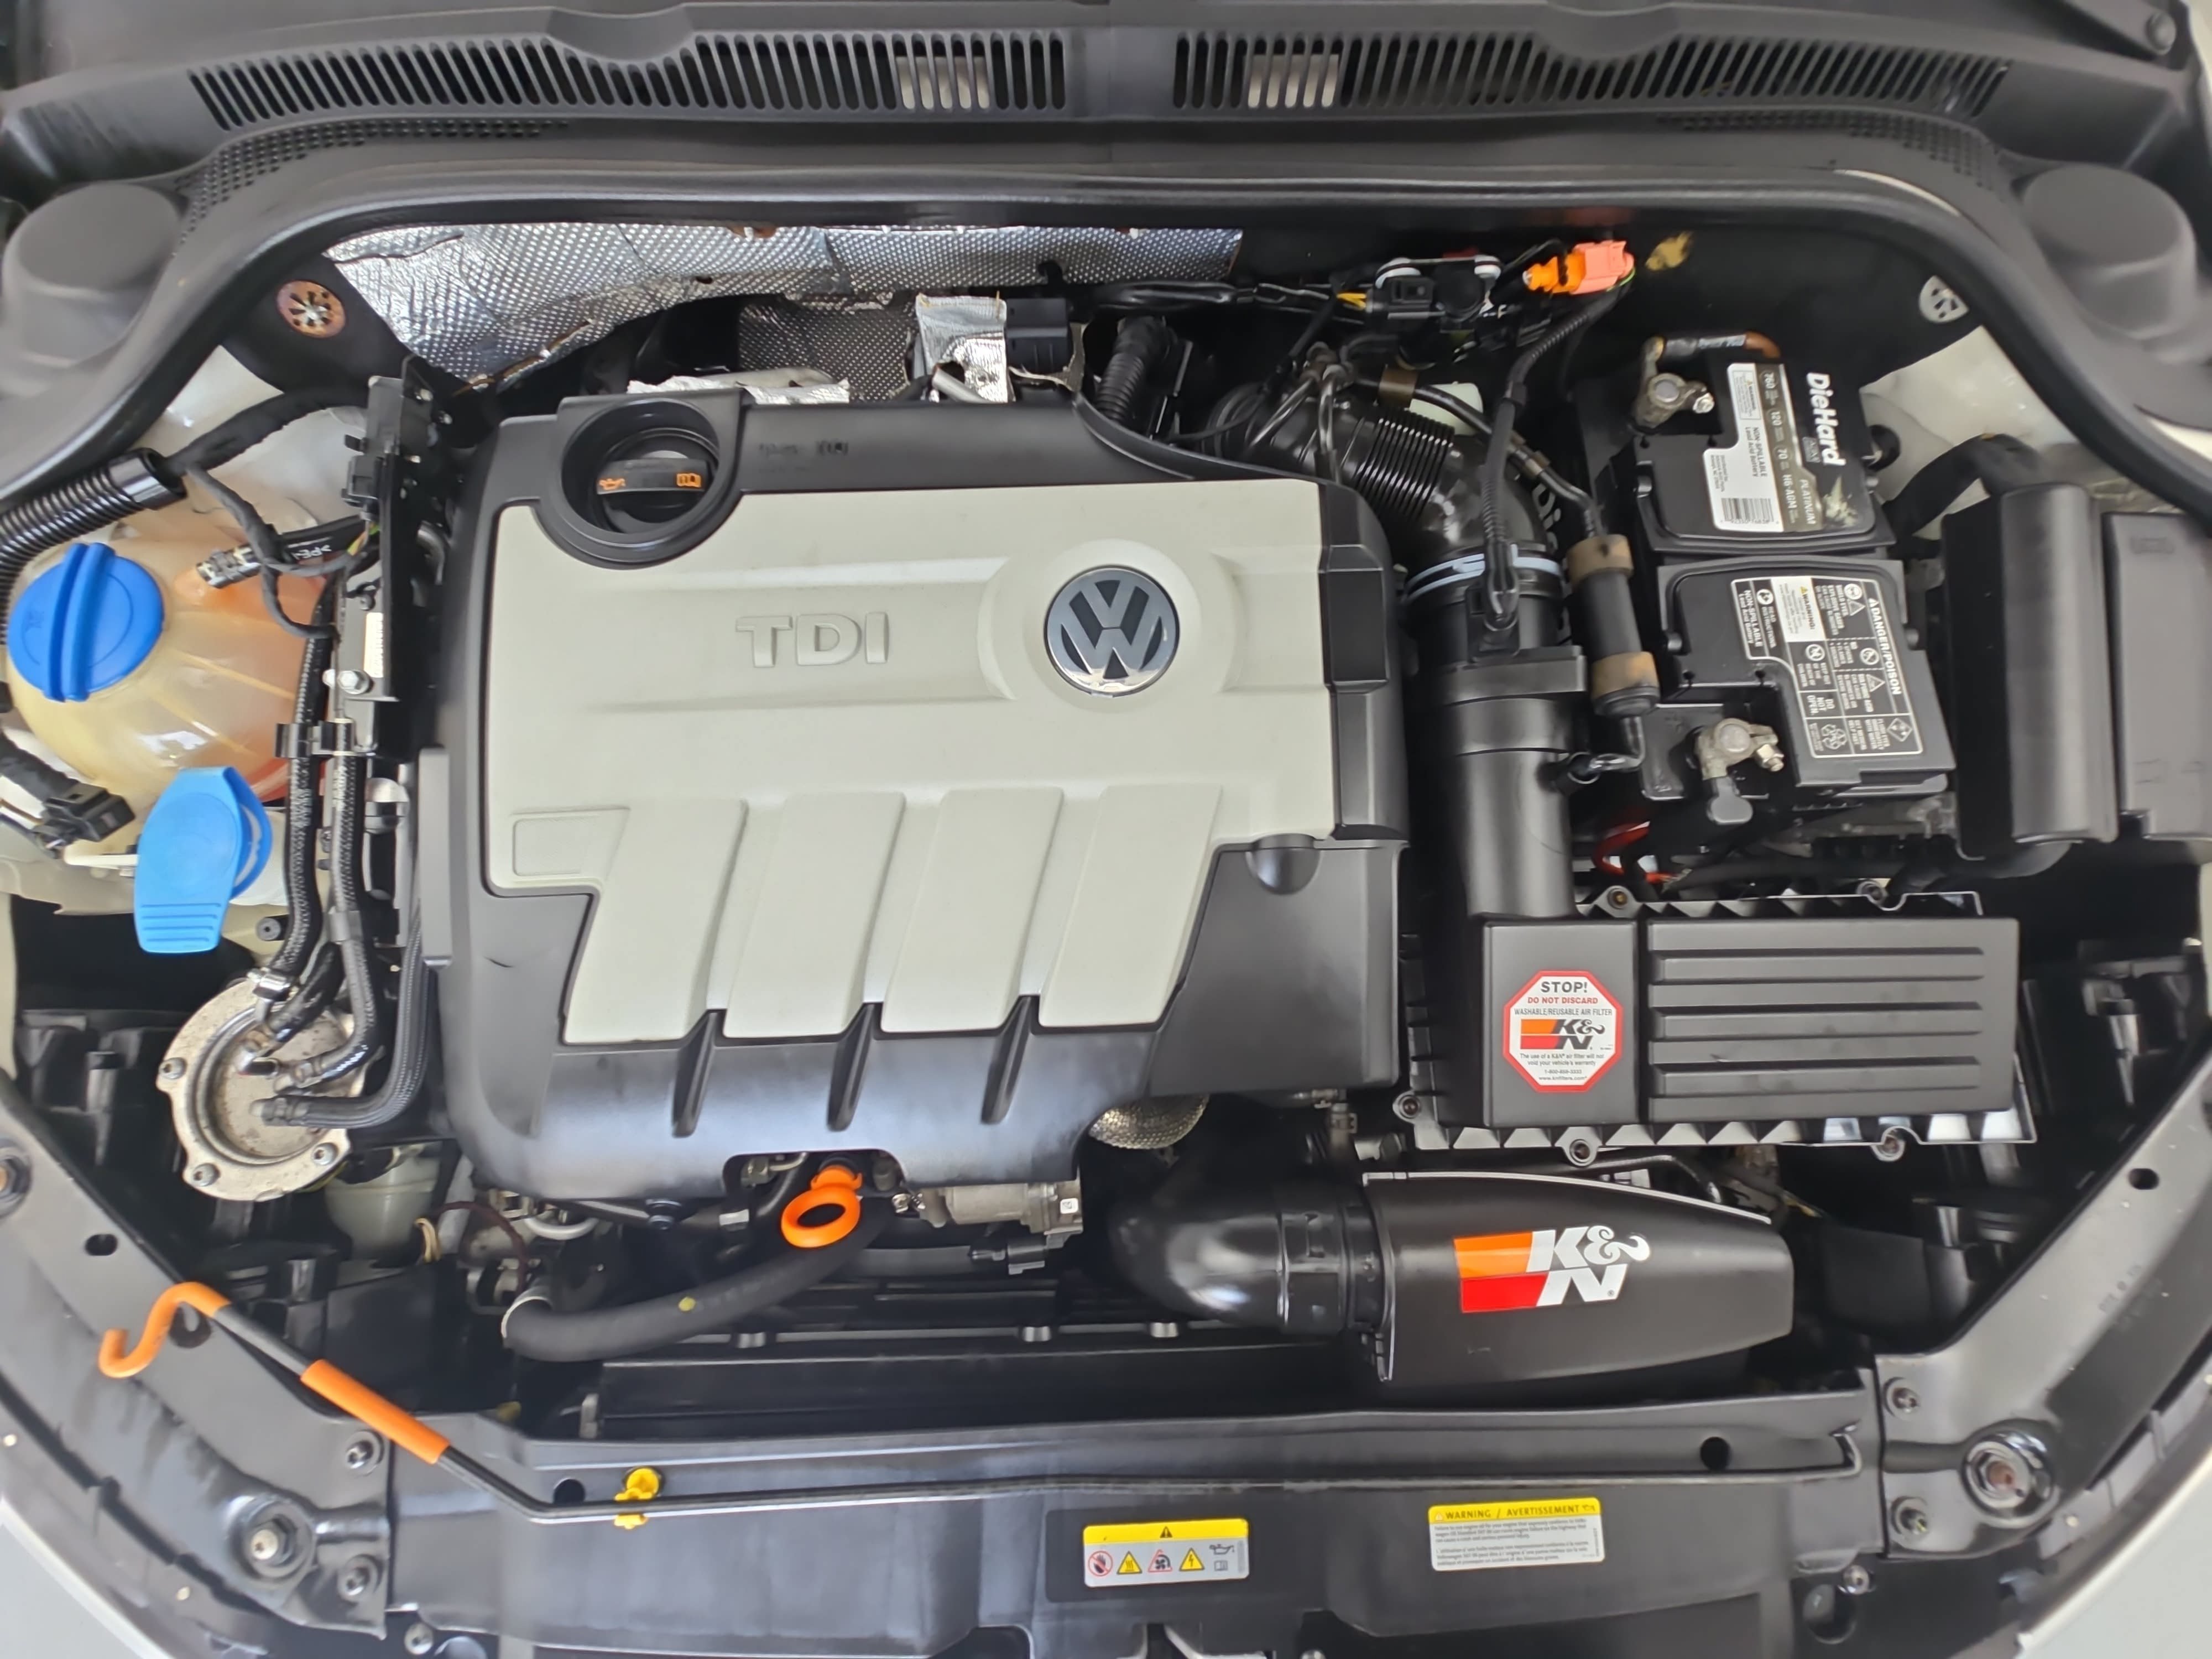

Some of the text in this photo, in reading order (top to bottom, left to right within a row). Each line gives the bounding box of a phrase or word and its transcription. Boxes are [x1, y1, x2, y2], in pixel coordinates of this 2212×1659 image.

[1764, 373, 1776, 388] 760
[1771, 412, 1782, 425] 120
[1806, 373, 1846, 466] DieHard
[1749, 456, 1759, 476] Battery
[1752, 427, 1767, 476] NON-SPILLABLE
[1778, 450, 1788, 460] 70
[1782, 475, 1797, 508] H6-AGM
[1799, 479, 1816, 523] PLATINUM
[1827, 586, 1839, 611] EXPLOSIVE
[1738, 594, 1755, 644] Lead Acid Battery
[1743, 591, 1764, 646] NON-SPILLABLE
[736, 613, 888, 667] TDI
[1870, 608, 1901, 695] DANGER/POISON
[1817, 697, 1827, 710] NOT
[1825, 700, 1835, 709] DO
[1541, 982, 1588, 993] STOP!
[1551, 1019, 1605, 1050] K&N
[1526, 1225, 1651, 1307] K&N
[1446, 1504, 1579, 1519] WARNING / AVERTISSEMENT
